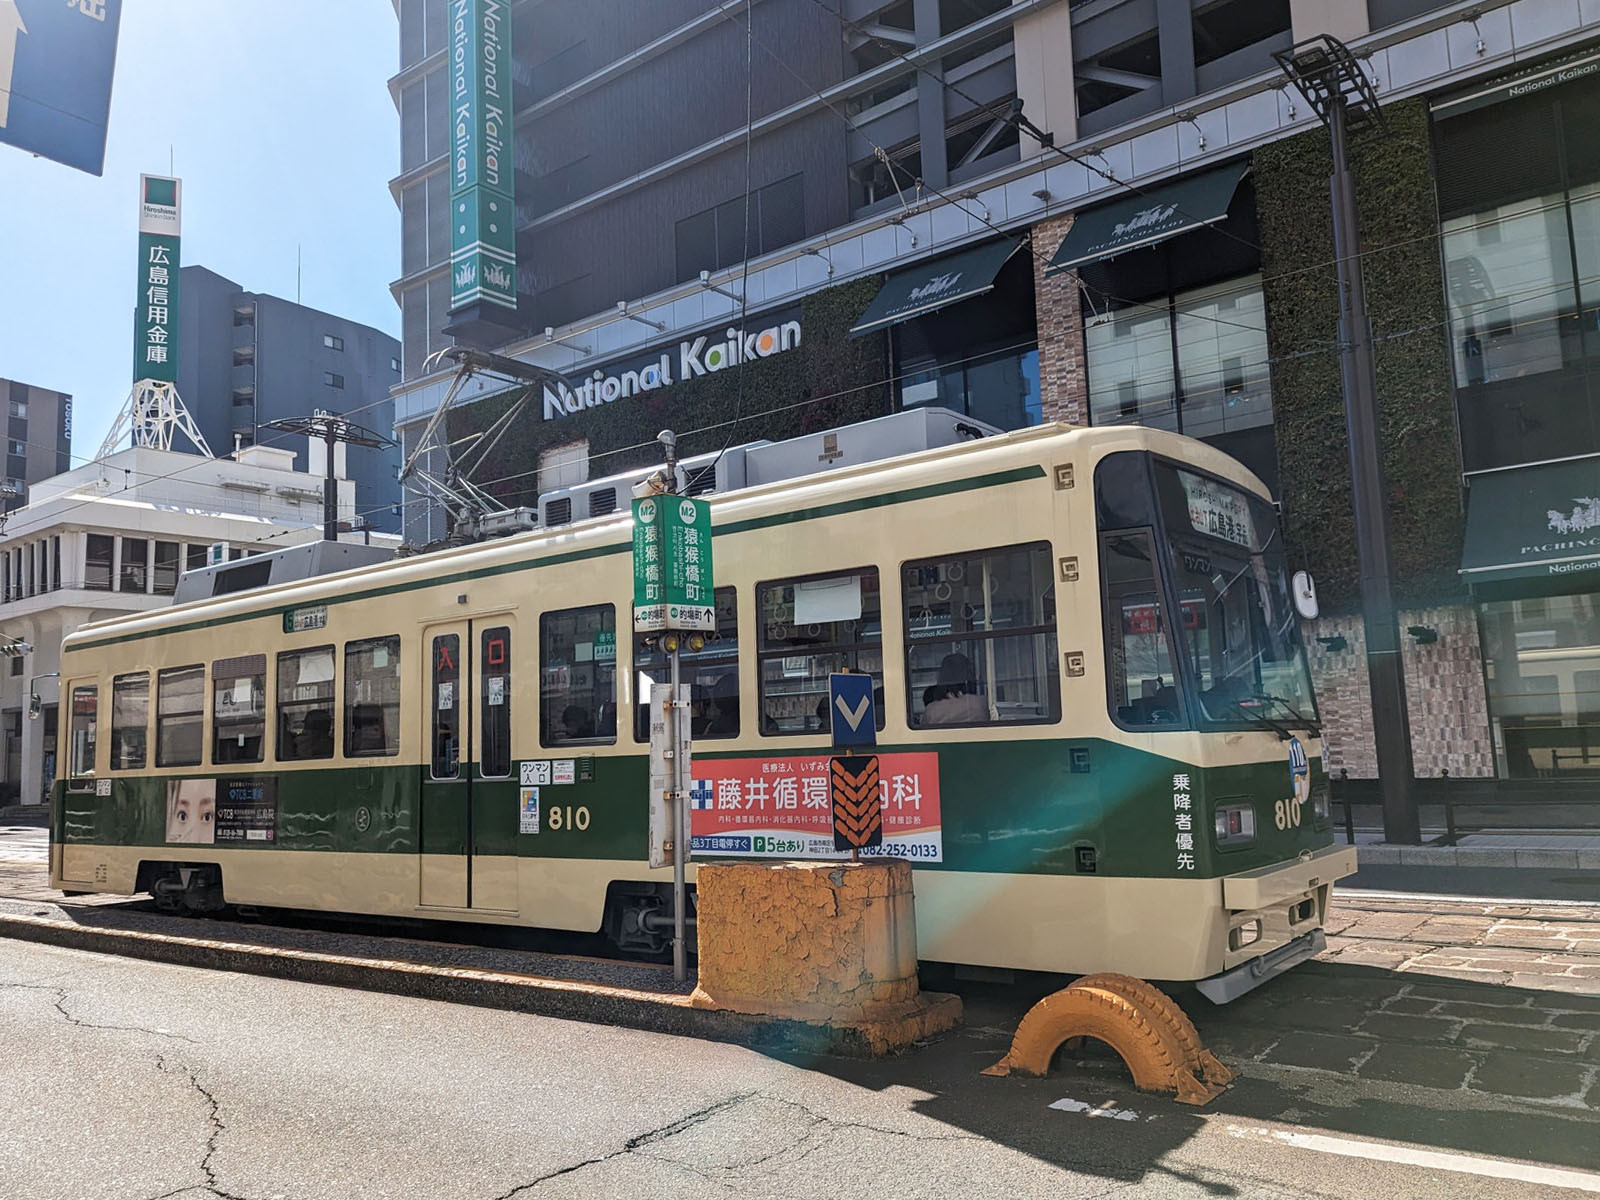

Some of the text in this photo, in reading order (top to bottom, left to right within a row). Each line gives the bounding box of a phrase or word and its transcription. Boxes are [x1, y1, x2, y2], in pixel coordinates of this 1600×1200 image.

[454, 0, 471, 188] National Kaikan
[483, 0, 504, 186] National Kaikan
[1508, 63, 1598, 97] National Kaikan
[143, 205, 177, 216] Hiroshima
[146, 245, 171, 364] 広島信用金庫
[542, 319, 801, 421] National Kaikan
[640, 506, 655, 517] M2
[681, 506, 695, 518] M2
[645, 525, 660, 600] 猿猴橋町
[684, 527, 700, 601] 猿猴橋町
[438, 639, 504, 671] 入 口
[521, 763, 549, 773] ワンマン
[762, 762, 794, 774] 医療法人
[717, 773, 922, 811] 藤井循環科
[548, 805, 591, 831] 810
[1172, 773, 1195, 871] 乗降者優先
[1275, 797, 1301, 831] 810
[690, 837, 748, 849] 品3丁目電停すぐ
[767, 837, 806, 853] 5台あり
[863, 843, 938, 858] 082-252-0133
